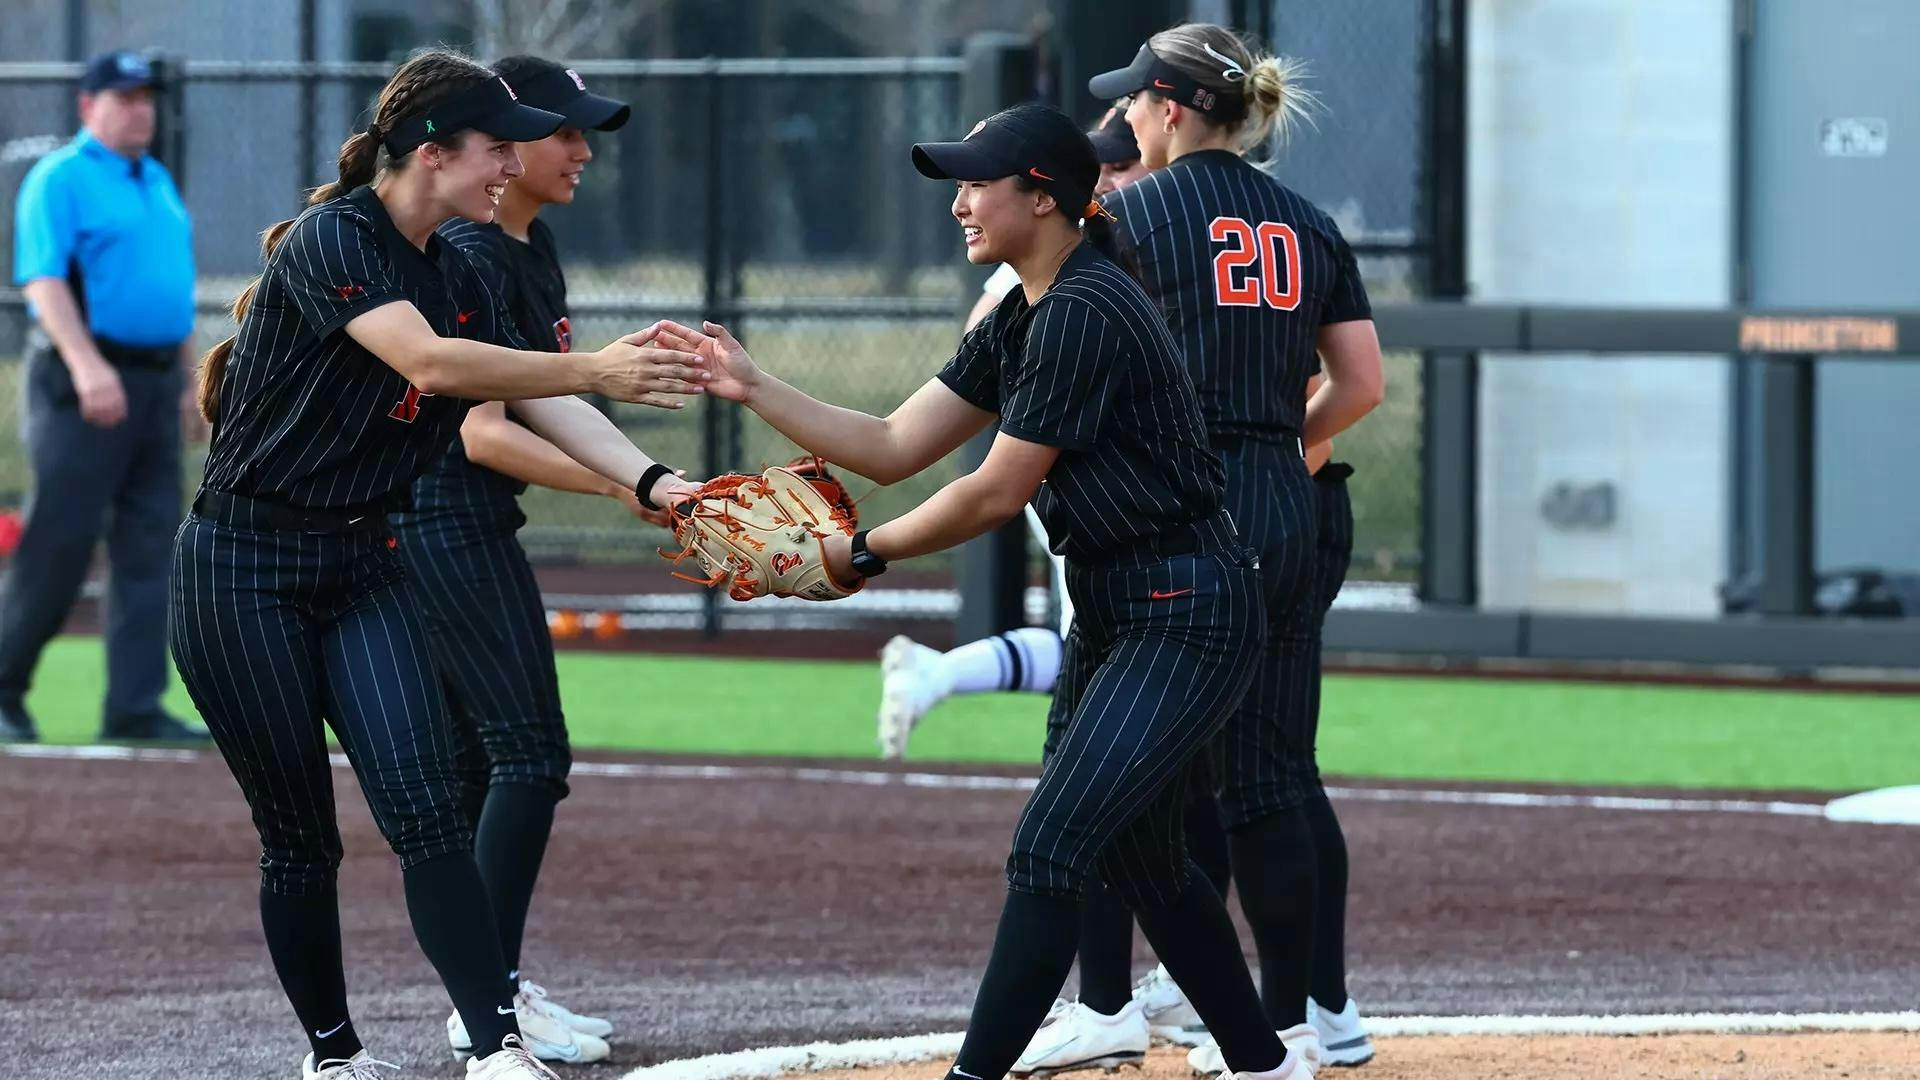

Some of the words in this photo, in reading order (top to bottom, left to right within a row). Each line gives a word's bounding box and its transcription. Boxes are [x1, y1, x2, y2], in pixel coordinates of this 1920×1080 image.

[1192, 88, 1216, 111] 20
[1209, 216, 1302, 311] 20
[1740, 317, 1897, 351] PRINCETON
